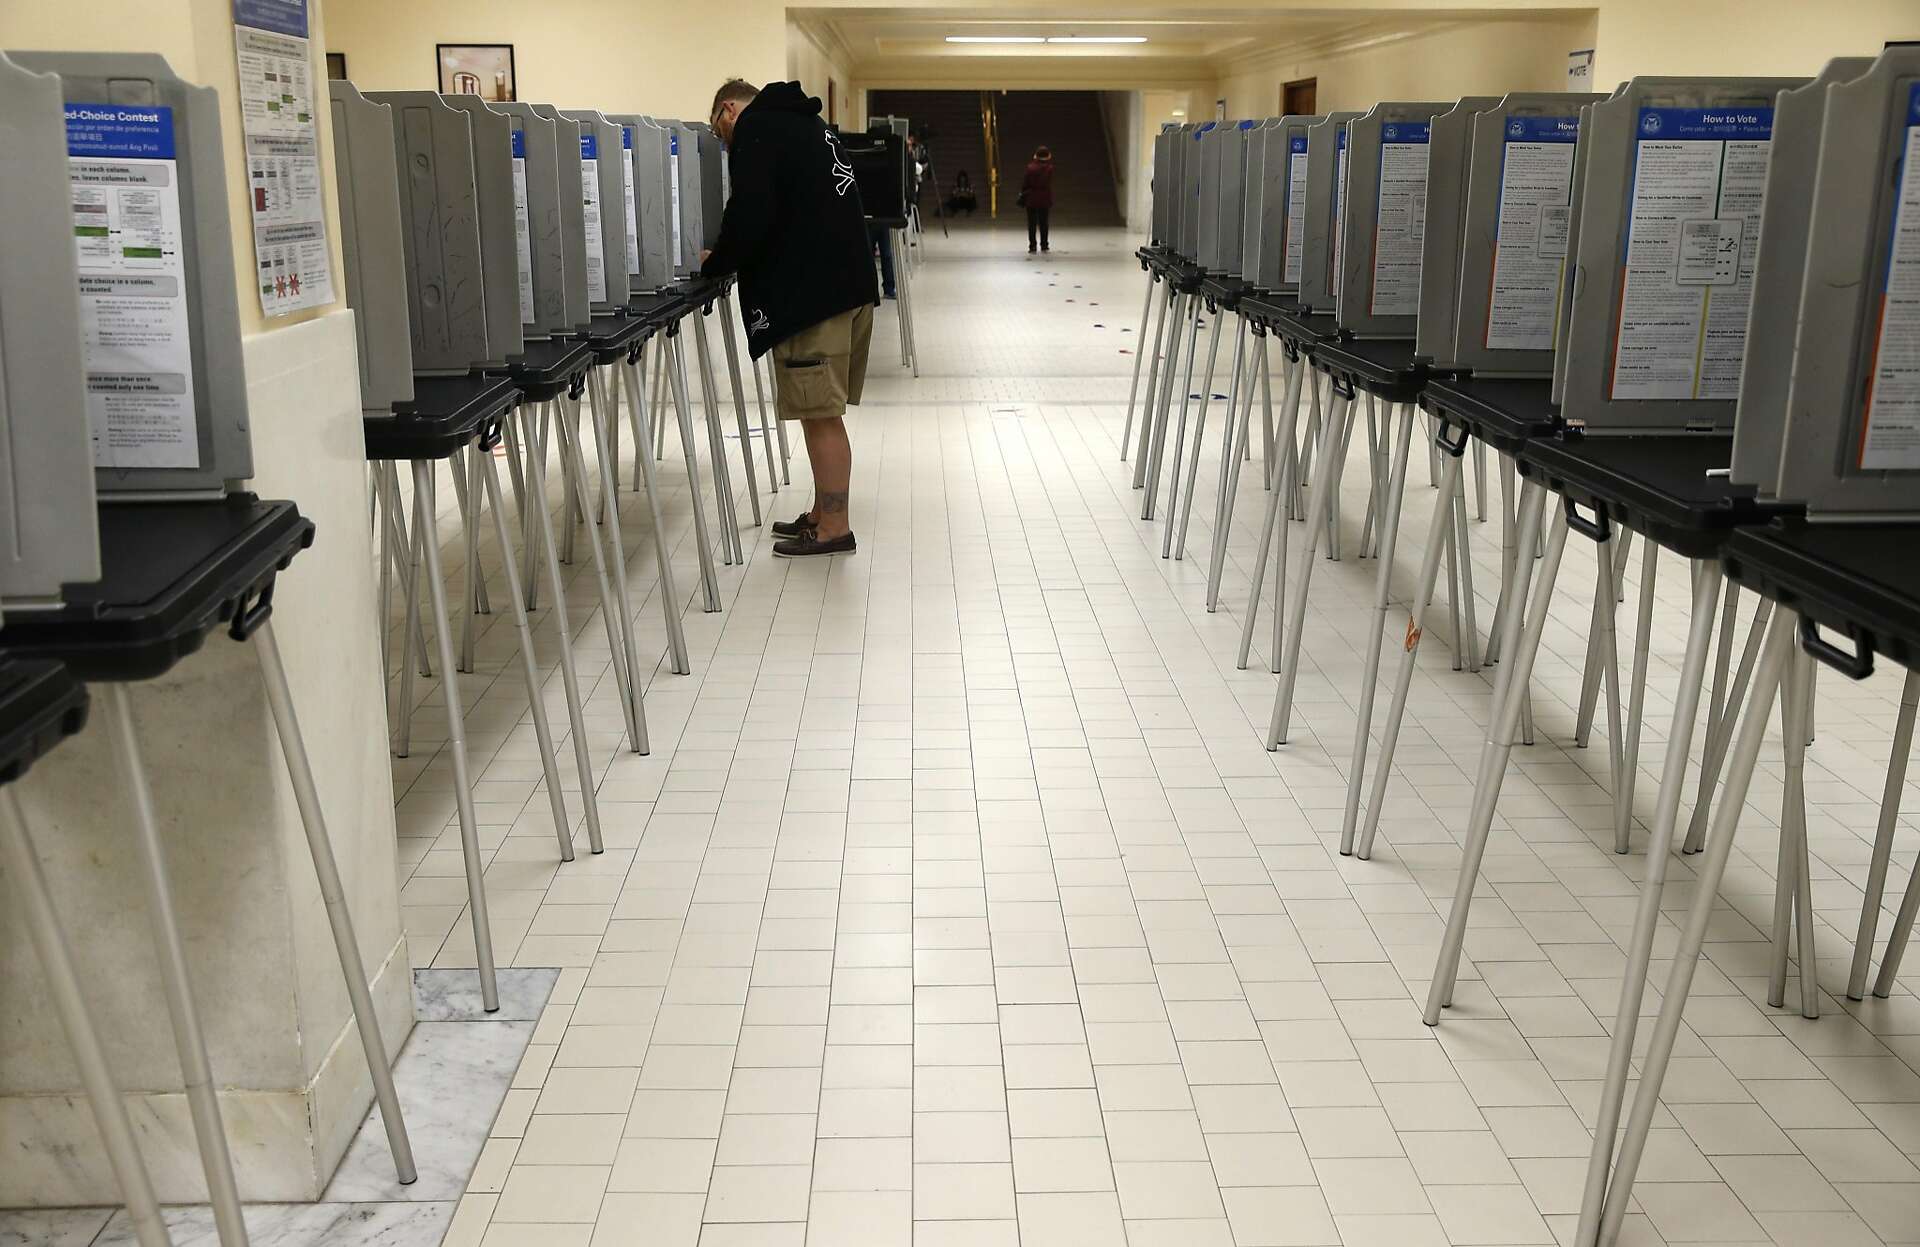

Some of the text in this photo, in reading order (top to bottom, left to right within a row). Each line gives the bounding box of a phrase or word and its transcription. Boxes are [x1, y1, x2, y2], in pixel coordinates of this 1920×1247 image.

[64, 110, 159, 123] ed-Choice Contest
[1702, 114, 1757, 124] How to Vote
[1557, 122, 1575, 130] How
